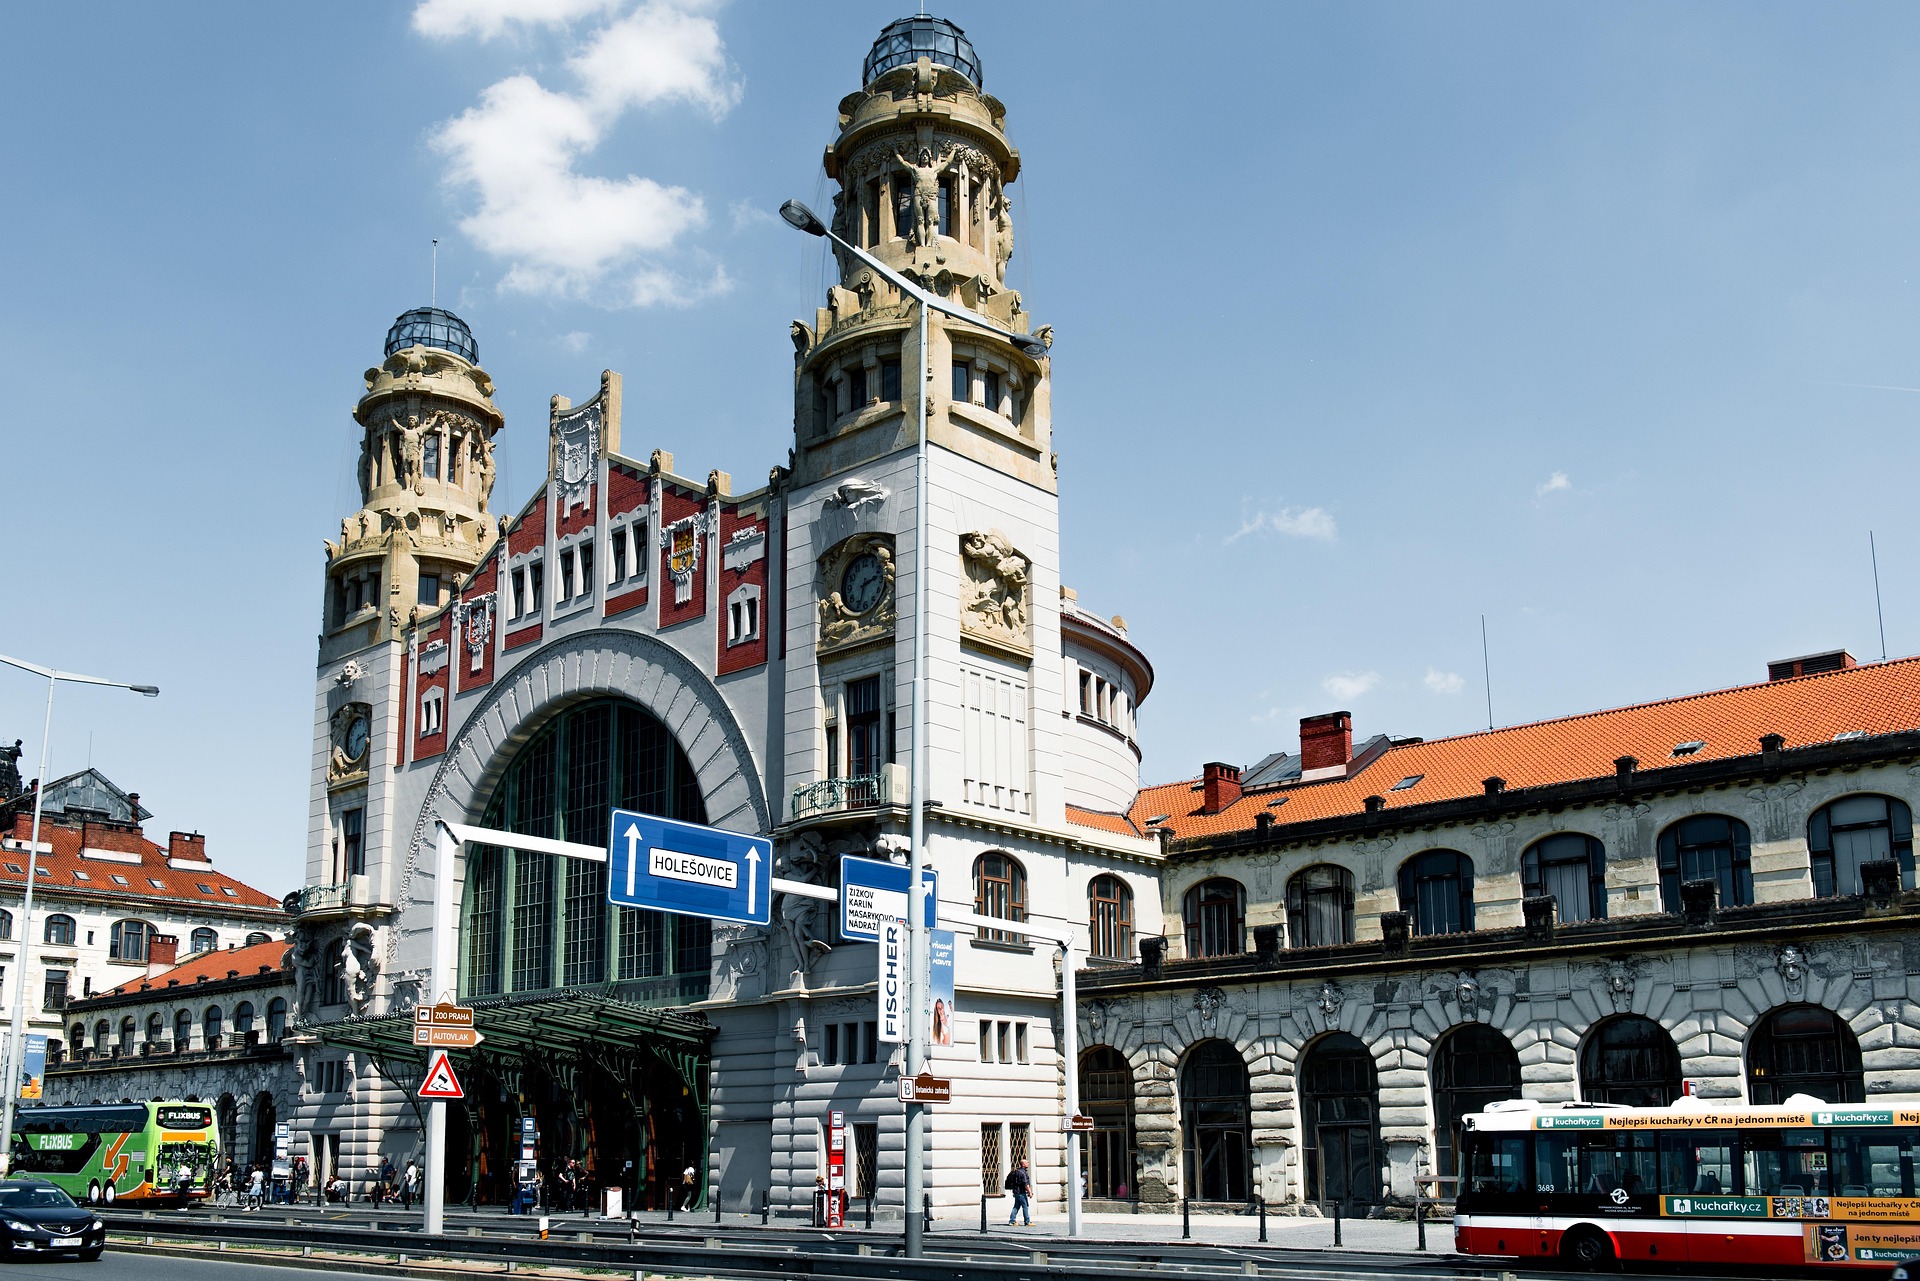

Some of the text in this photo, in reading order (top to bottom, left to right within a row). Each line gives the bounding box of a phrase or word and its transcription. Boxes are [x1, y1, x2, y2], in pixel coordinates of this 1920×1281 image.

[655, 855, 732, 881] HOLEŠOVICE
[849, 886, 875, 899] ŽIŽKOV
[849, 898, 873, 909] KARLÍN
[849, 909, 895, 922] MASARYKOVO
[886, 926, 897, 1036] FISCHER
[435, 1011, 470, 1021] ZOO PRAHA
[433, 1032, 469, 1041] AUTOVLAK
[1555, 1117, 1600, 1126] kuchařky.cz
[1609, 1117, 1647, 1127] Nejlepší
[1650, 1116, 1693, 1127] kuchařky
[1704, 1115, 1718, 1124] ČR
[1735, 1115, 1774, 1126] jednom
[1777, 1115, 1805, 1123] místě
[1834, 1113, 1888, 1122] kuchařky.cz
[1537, 1184, 1555, 1192] 3683
[1694, 1201, 1761, 1213] kuchařky.cz
[1836, 1201, 1867, 1209] Nejlepší
[1868, 1201, 1902, 1209] kuchařky
[1859, 1210, 1888, 1218] jednom
[1872, 1235, 1881, 1244] ty
